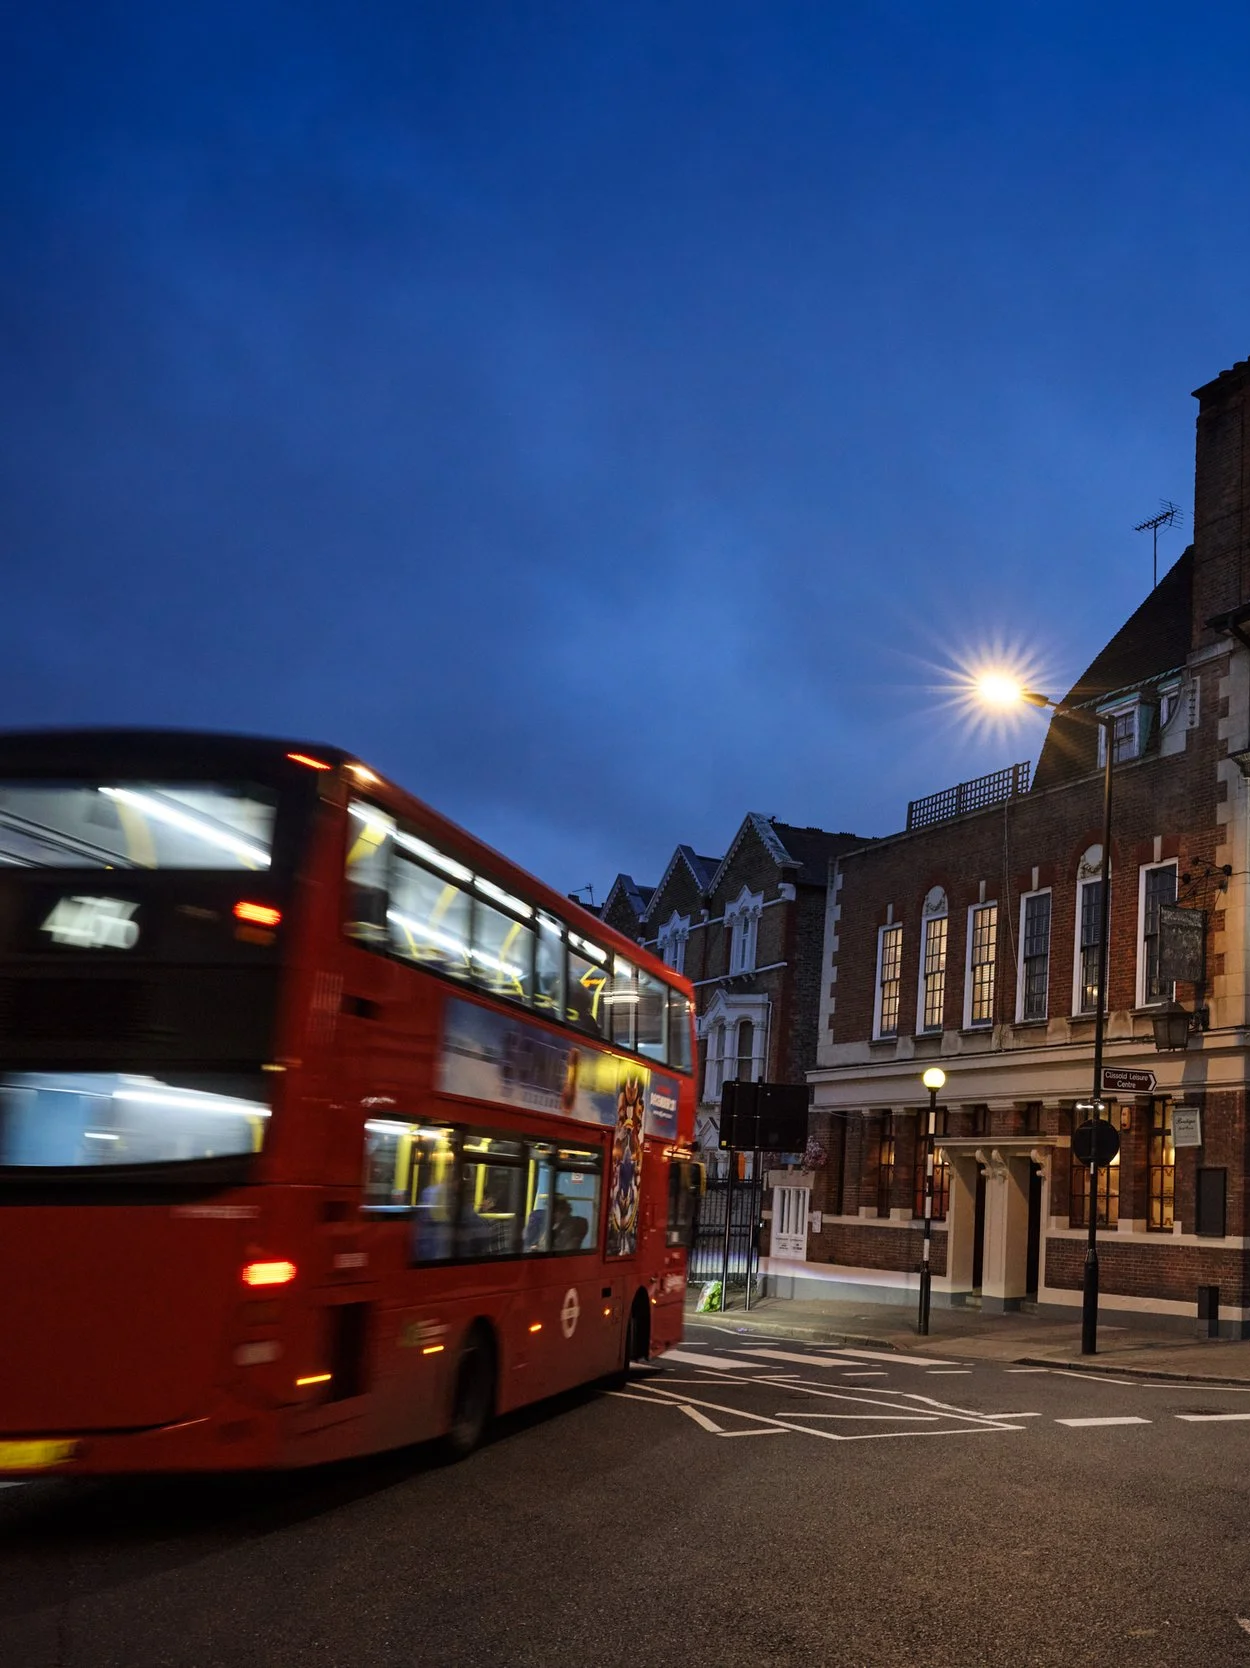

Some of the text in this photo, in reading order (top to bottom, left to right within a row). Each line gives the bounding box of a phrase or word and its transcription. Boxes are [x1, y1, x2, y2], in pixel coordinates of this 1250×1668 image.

[1105, 1071, 1149, 1082] Clissold Leisure
[1116, 1080, 1137, 1089] Centre
